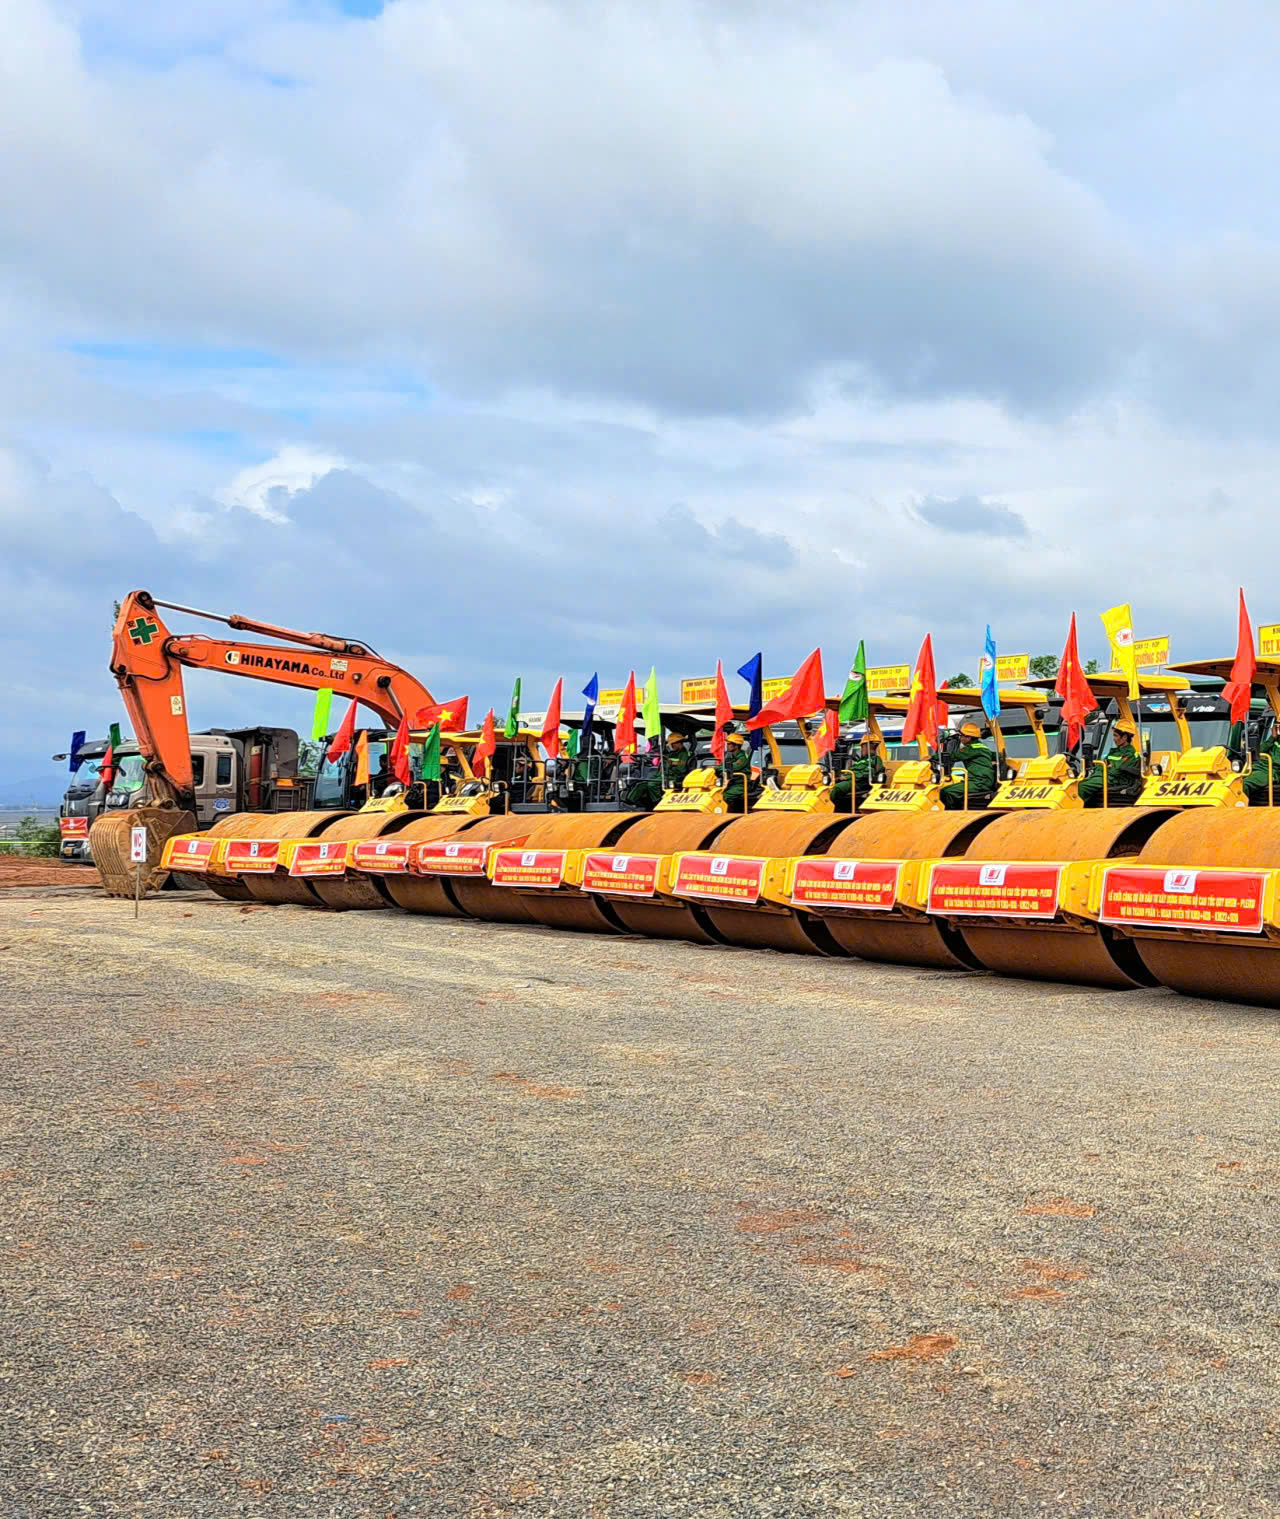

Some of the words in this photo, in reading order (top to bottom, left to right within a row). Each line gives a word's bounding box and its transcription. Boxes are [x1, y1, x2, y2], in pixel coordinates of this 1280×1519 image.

[240, 653, 310, 675] HIRAYAMA
[1005, 786, 1053, 800] SAKAI
[1154, 782, 1214, 797] SAKAI
[667, 793, 703, 804] SAKAI
[767, 791, 808, 803] SAKAI
[875, 790, 916, 803] SAKAI
